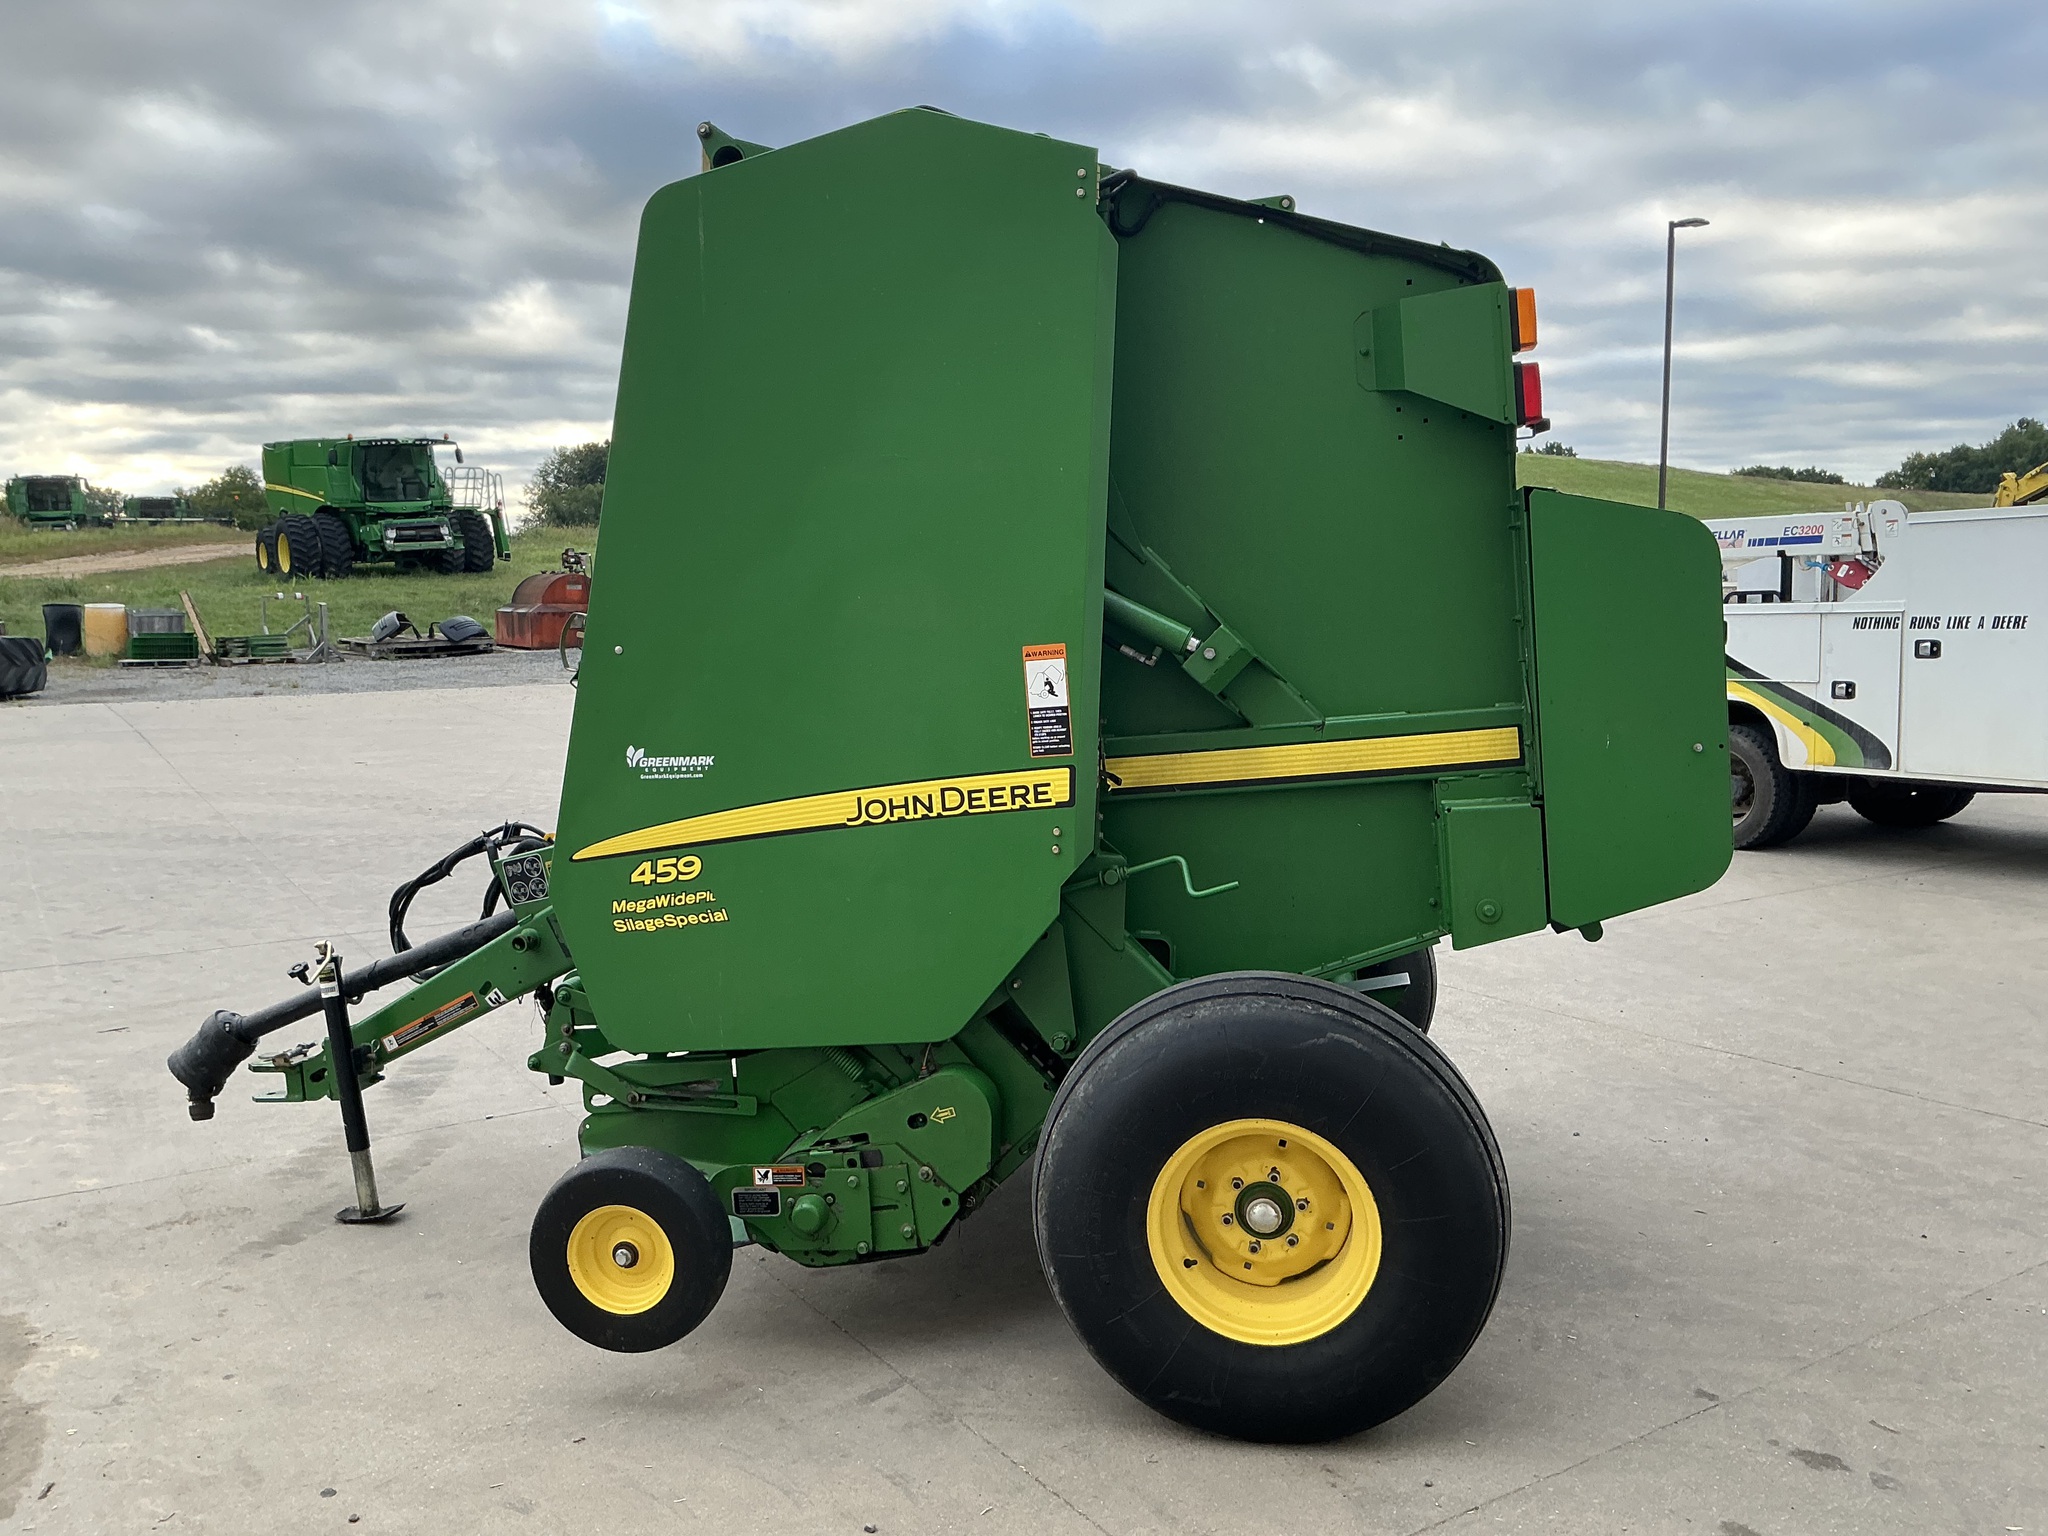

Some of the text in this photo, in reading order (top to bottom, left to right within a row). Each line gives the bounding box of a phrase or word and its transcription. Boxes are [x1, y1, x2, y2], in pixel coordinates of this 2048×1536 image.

[1783, 525, 1824, 536] EC3200
[1852, 615, 2028, 630] NOTHING RUNS LIKE A DEERE
[1031, 649, 1064, 657] WARNING
[640, 755, 715, 768] GREENMARK
[846, 782, 1053, 823] JOHN DEERE
[630, 854, 703, 886] 459
[612, 908, 730, 933] SilageSpecial
